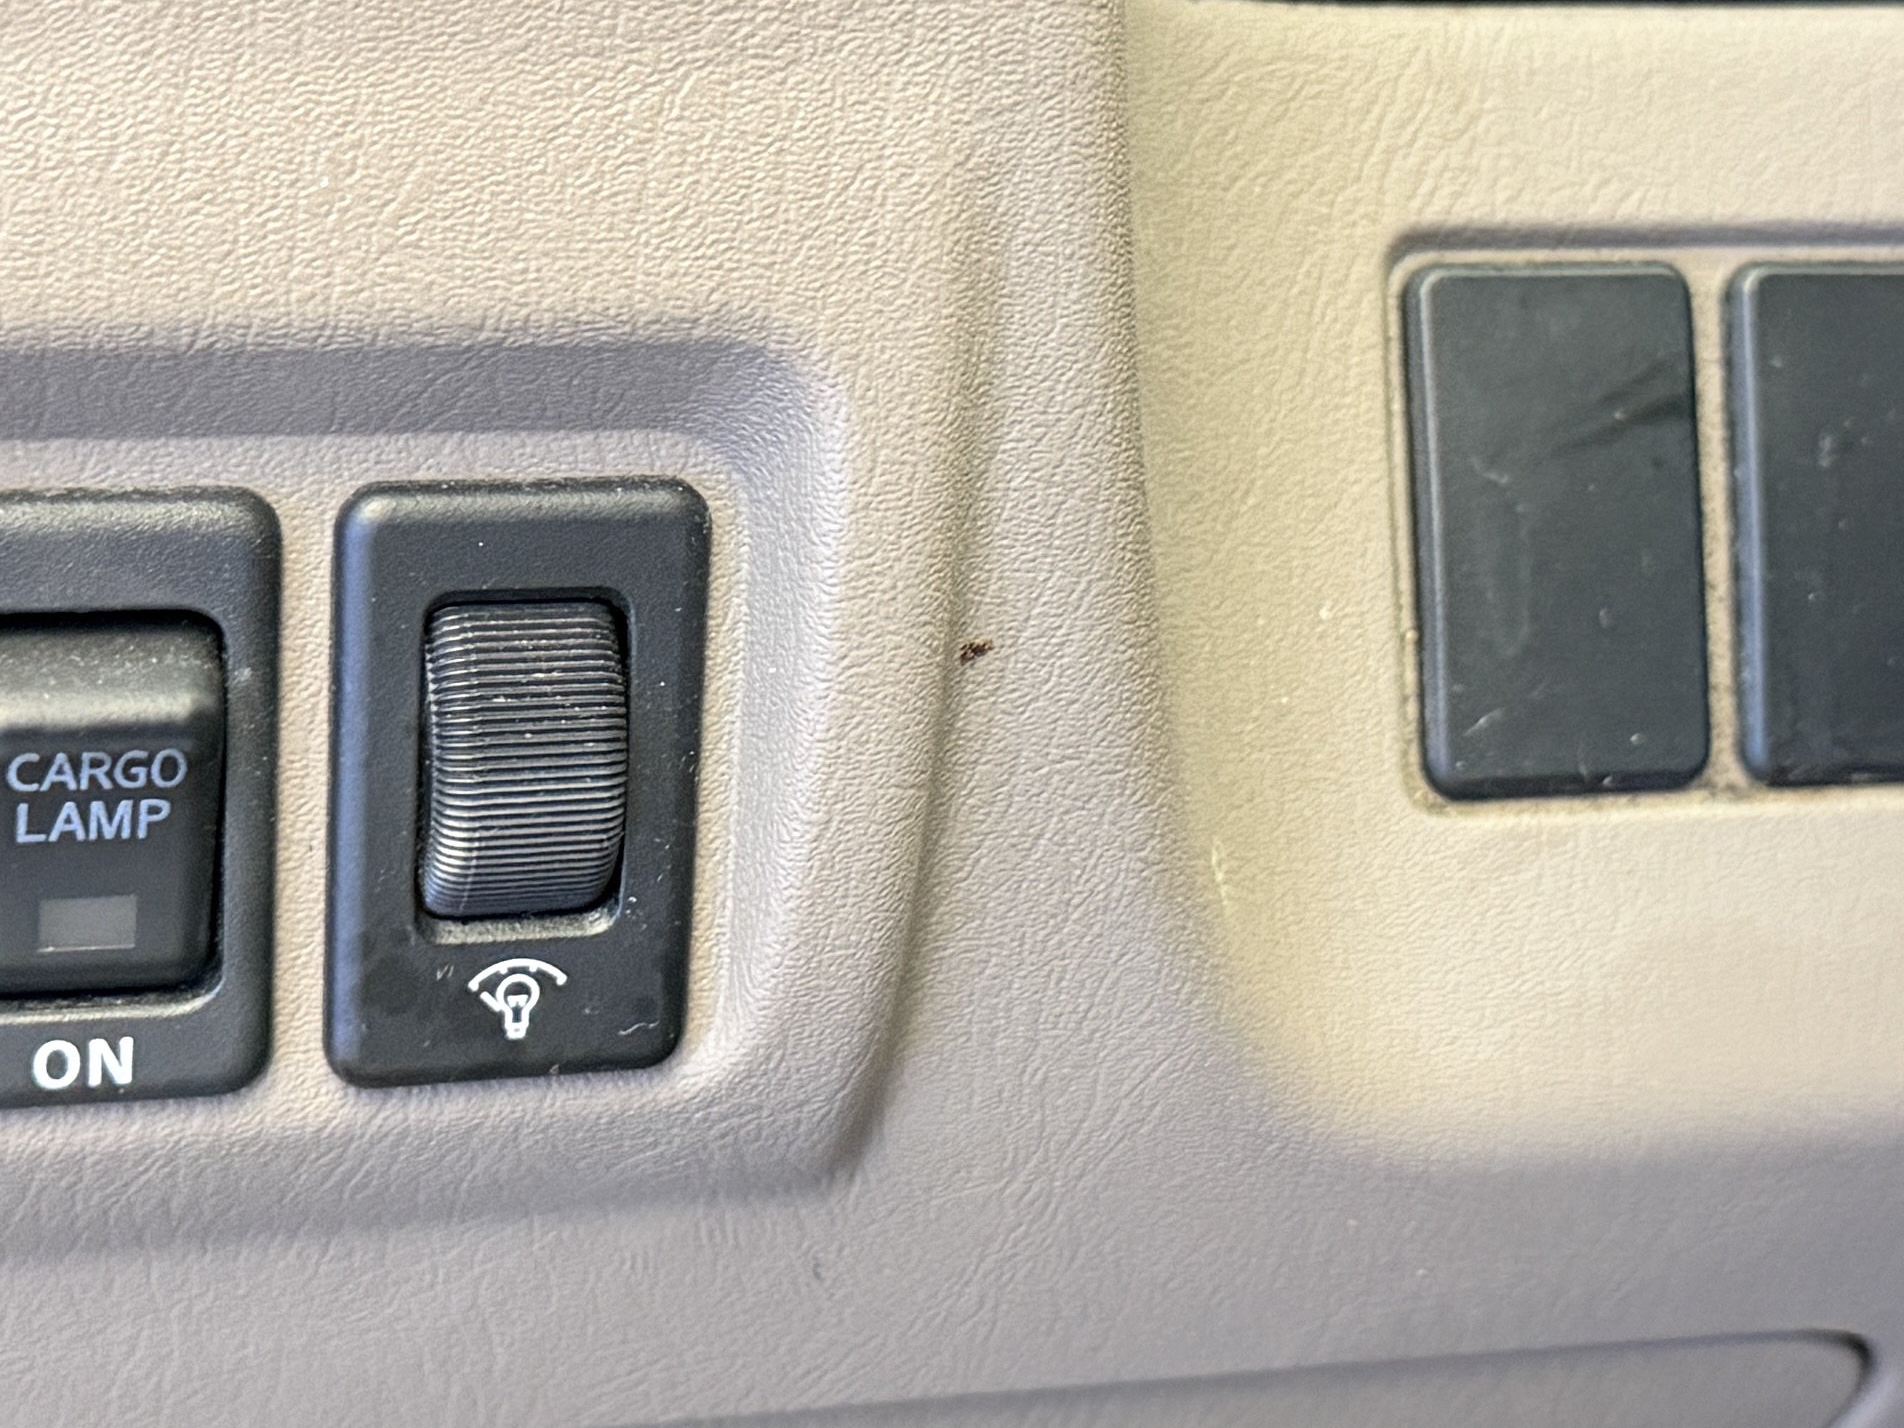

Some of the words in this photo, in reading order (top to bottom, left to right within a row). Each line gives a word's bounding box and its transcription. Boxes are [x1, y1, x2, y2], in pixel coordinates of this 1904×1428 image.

[7, 748, 187, 793] CARGO
[15, 798, 171, 846] LAMP
[31, 1036, 135, 1090] ON
